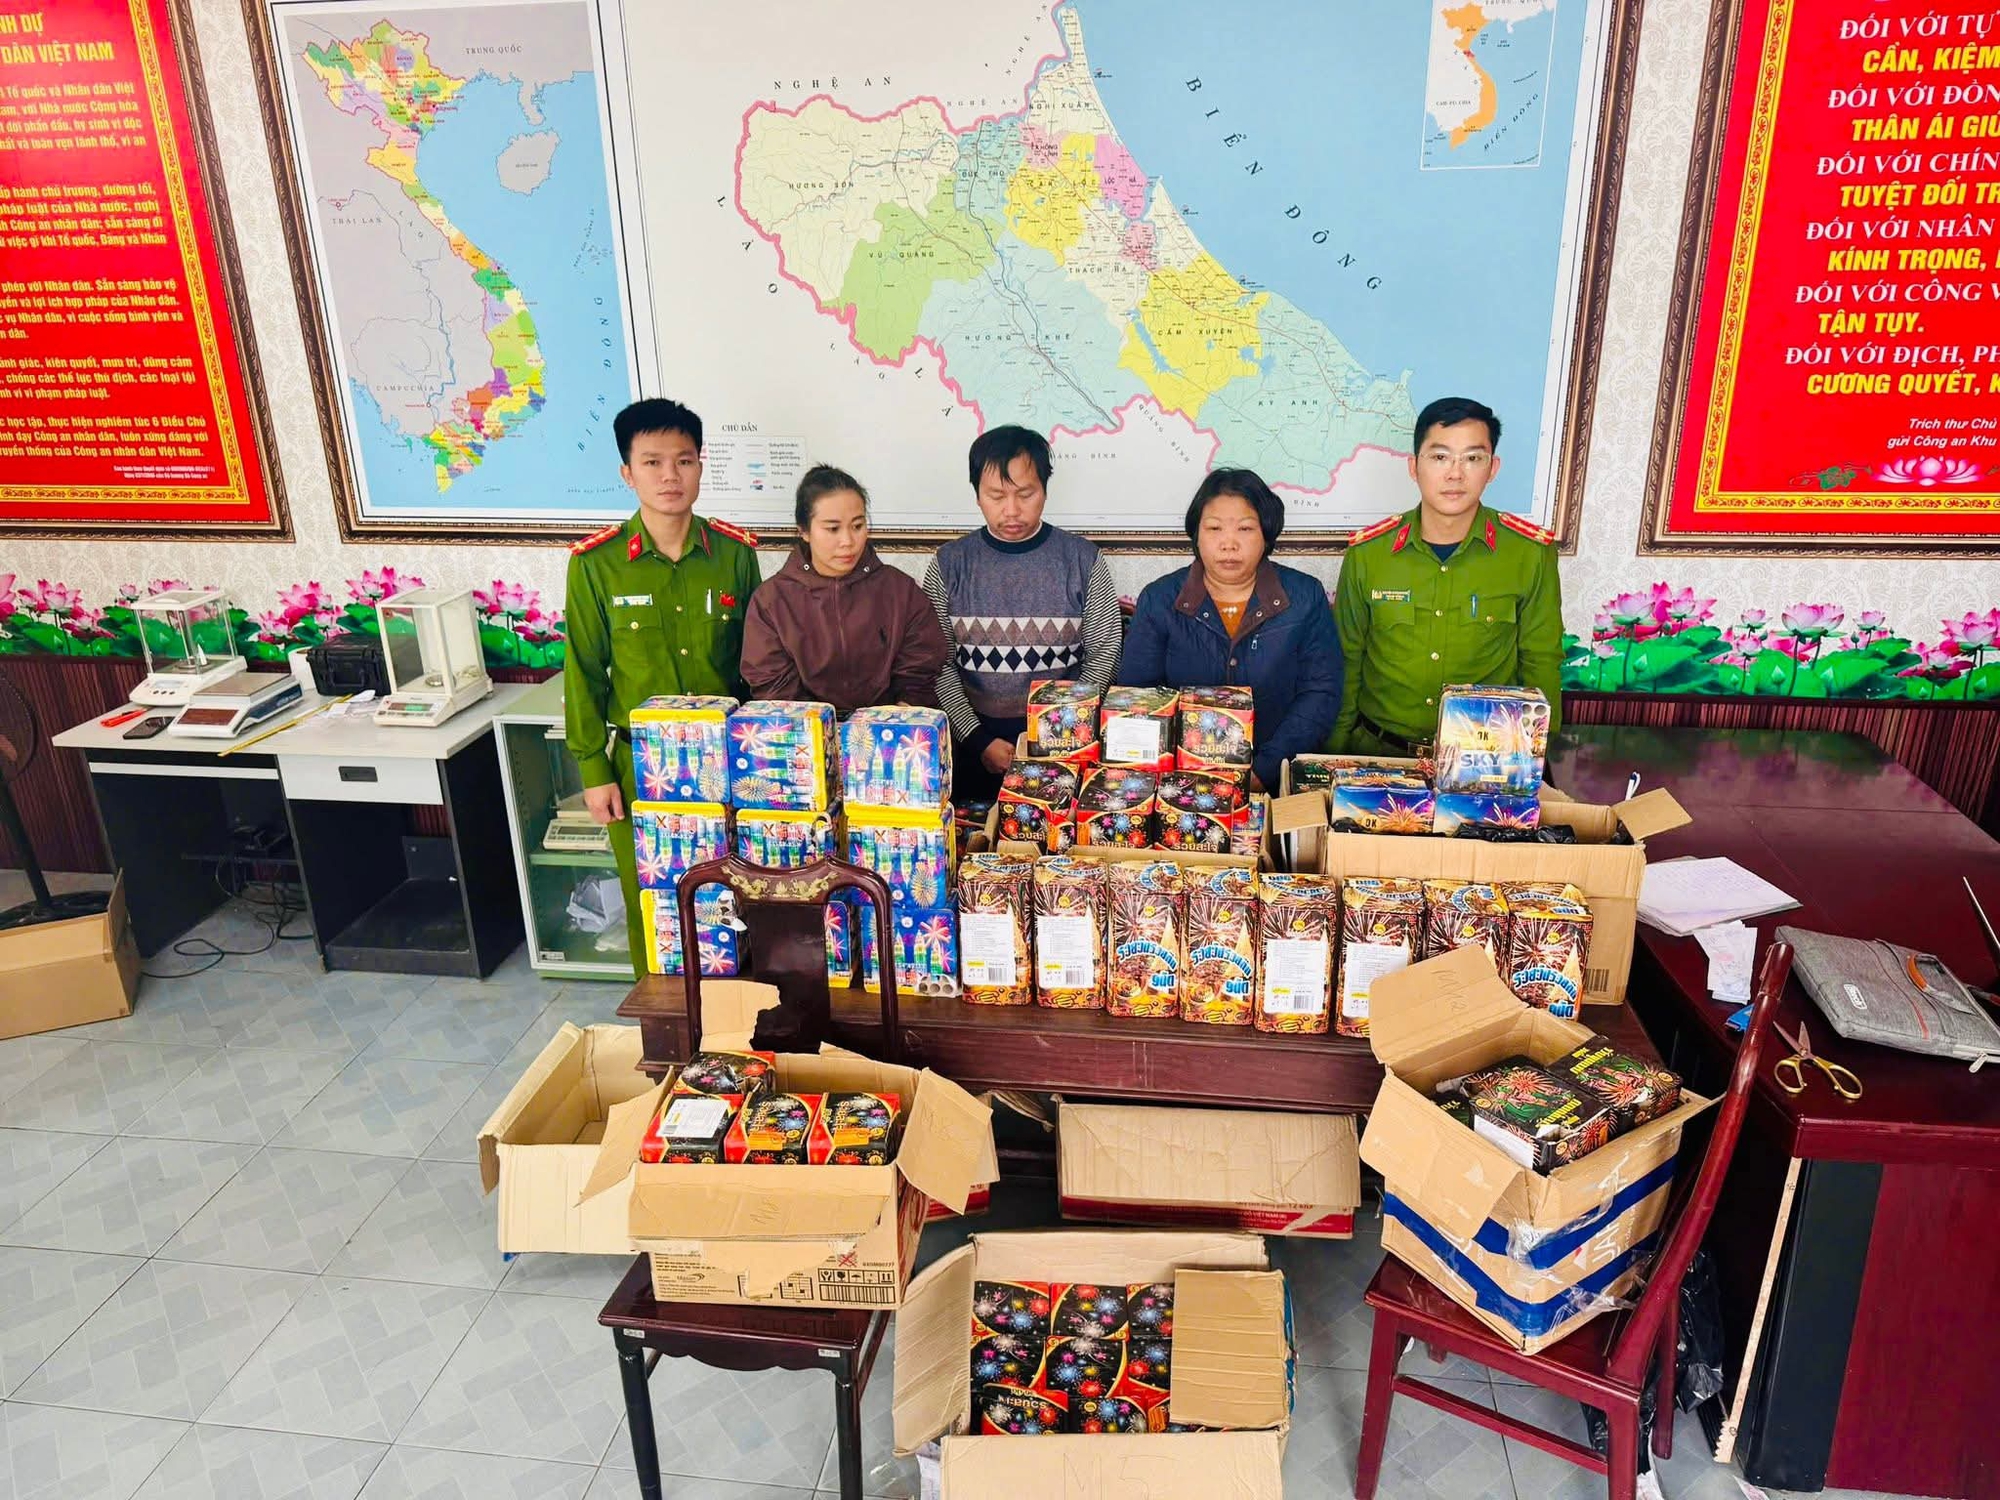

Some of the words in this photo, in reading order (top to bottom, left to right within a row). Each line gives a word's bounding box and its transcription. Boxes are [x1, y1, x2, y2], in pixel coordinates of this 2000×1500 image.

[1839, 13, 1889, 39] ĐỐI
[1900, 10, 1948, 36] VỚI
[1, 42, 36, 64] DÂN
[38, 40, 72, 68] VIỆT
[74, 42, 114, 61] NAM
[1862, 42, 1924, 73] CẦN,
[1827, 83, 1877, 108] ĐỐI
[1887, 81, 1934, 106] VỚI
[1852, 114, 1920, 141] THÂN
[1925, 112, 1954, 139] ÁI
[1816, 151, 1865, 175] ĐỐI
[1874, 148, 1923, 174] VỚI
[1186, 76, 1263, 177] BIỂN
[1284, 204, 1383, 291] ĐÔNG
[1841, 180, 1914, 210] TUYỆT
[1921, 178, 1967, 205] ĐỐI
[1806, 216, 1854, 240] ĐỐI
[1862, 215, 1909, 238] VỚI
[1916, 213, 1994, 237] NHÂN
[1827, 246, 1890, 271] KÍNH
[1898, 247, 1987, 273] TRỌNG,
[1795, 281, 1842, 303] ĐỐI
[1851, 279, 1898, 303] VỚI
[1903, 278, 1982, 302] CÔNG
[1818, 309, 1866, 337] TẬN
[1874, 312, 1924, 337] TỤY.
[1785, 342, 1831, 364] ĐỐI
[1840, 341, 1885, 364] VỚI
[1892, 345, 1964, 369] ĐỊCH,
[1806, 372, 1892, 394] CƯƠNG
[1897, 367, 1980, 395] QUYẾT,
[1909, 418, 1941, 429] Trích
[1944, 418, 1969, 429] thư
[1970, 418, 1997, 429] Chủ
[1887, 436, 1911, 449] gửi
[1913, 435, 1948, 448] Công
[1950, 437, 1967, 446] an
[1969, 435, 1997, 446] Khu
[1459, 753, 1501, 768] SKY
